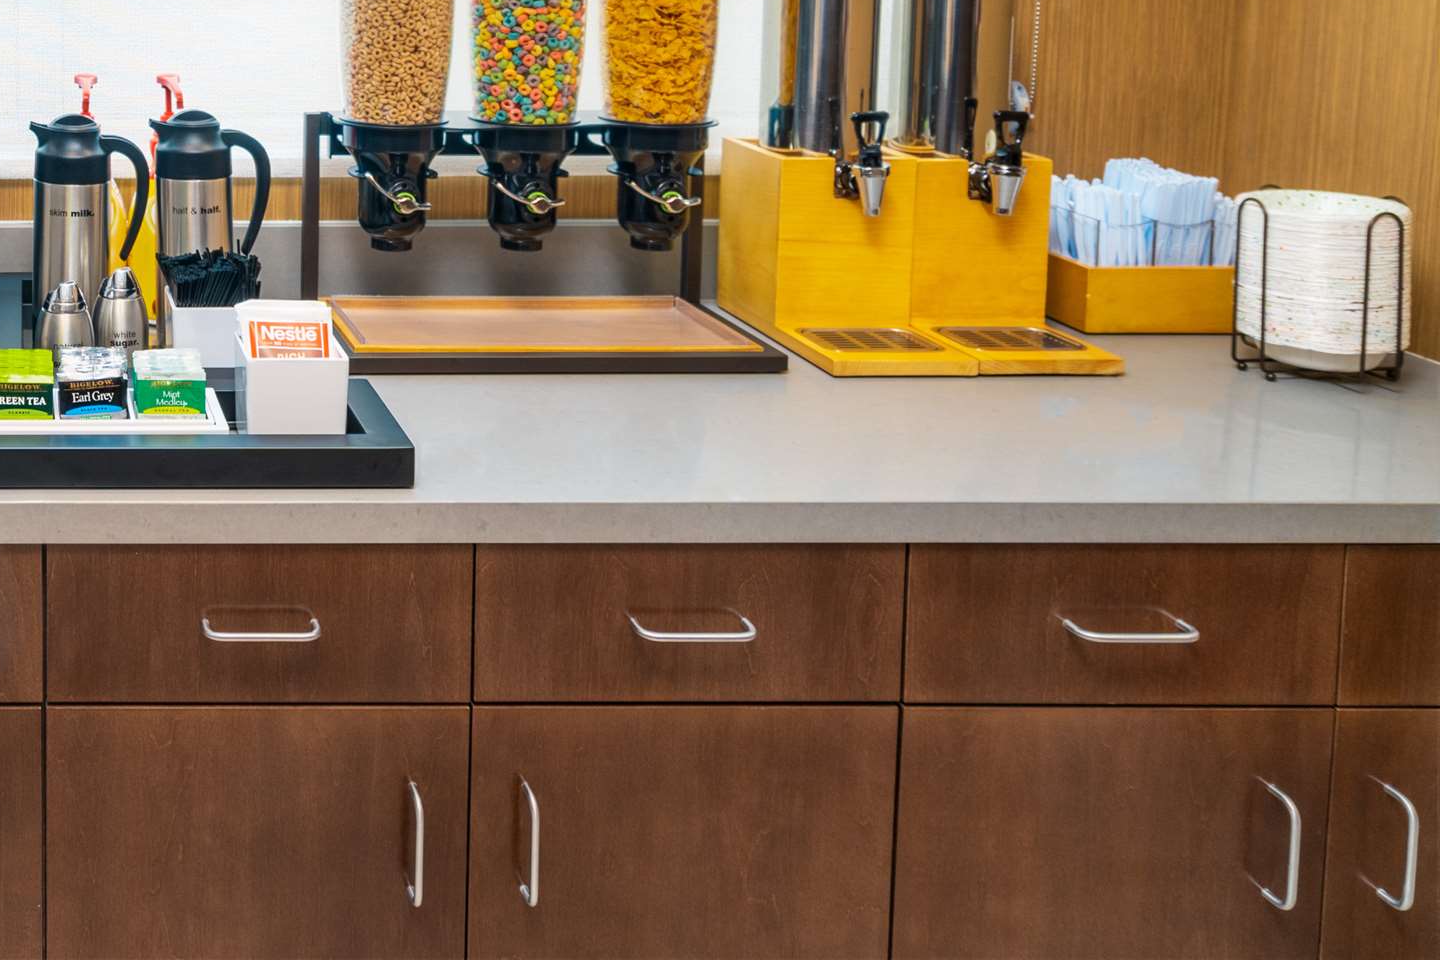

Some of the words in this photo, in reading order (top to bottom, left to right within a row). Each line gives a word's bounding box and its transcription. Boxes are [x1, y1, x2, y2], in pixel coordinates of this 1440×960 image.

[49, 208, 68, 217] skim
[191, 207, 197, 215] &
[113, 331, 136, 339] white
[70, 379, 114, 389] BIGELOW
[27, 396, 47, 406] TEA
[71, 392, 91, 403] Earl
[92, 390, 114, 403] Grey
